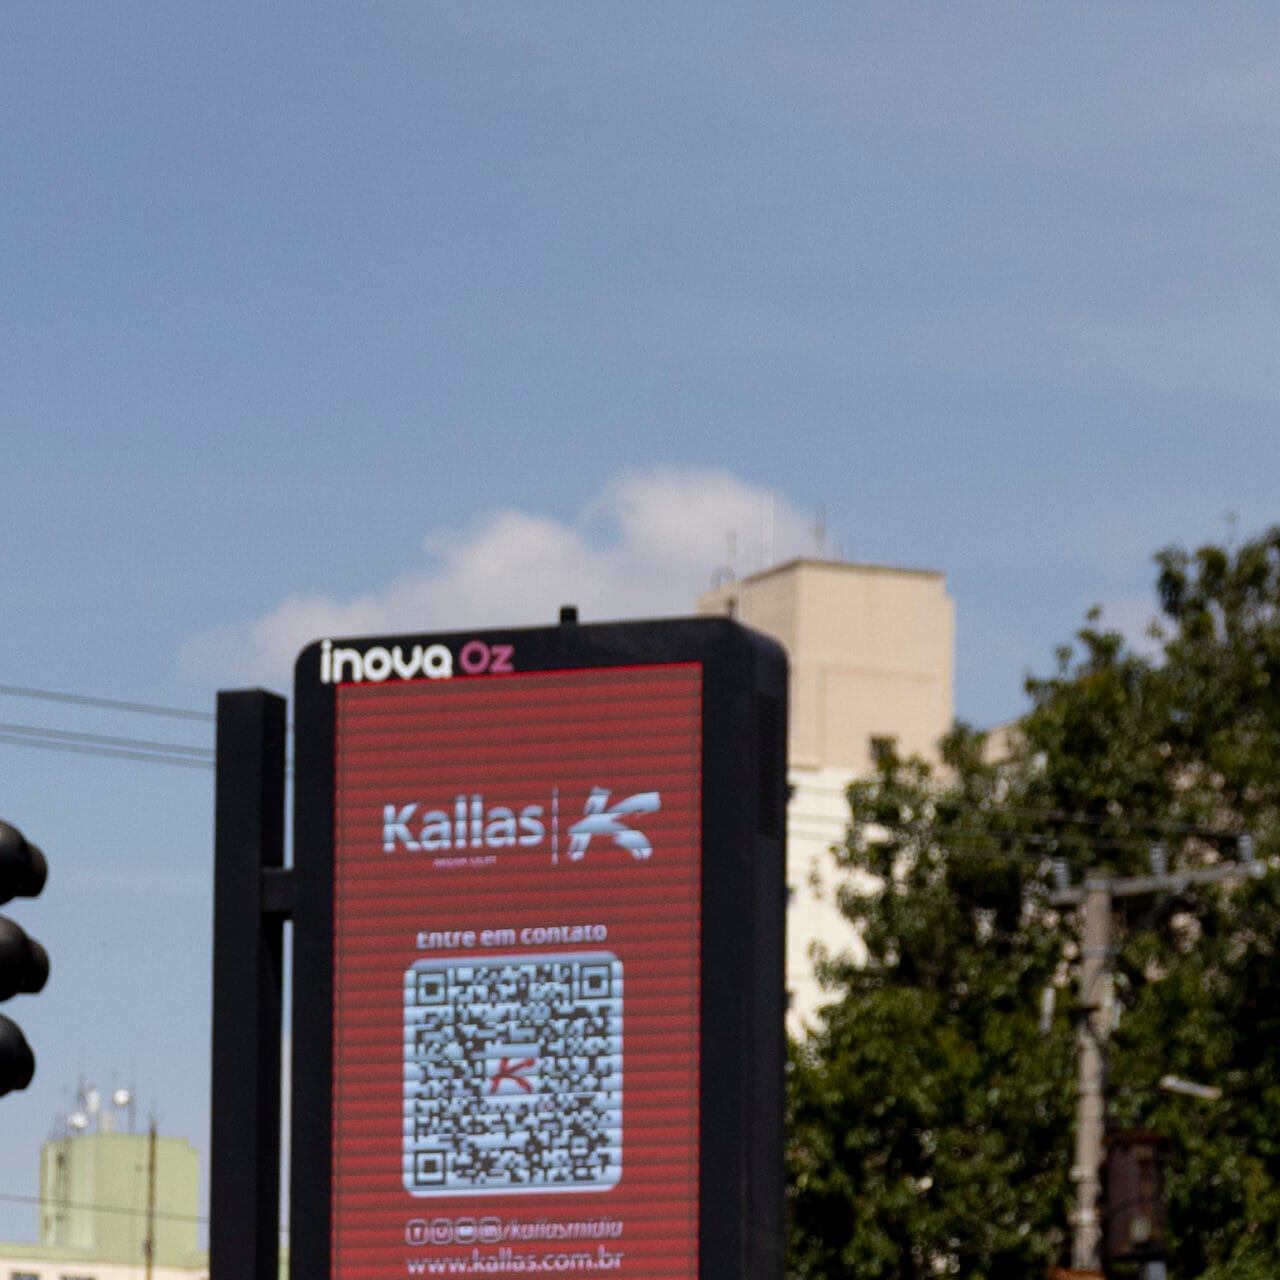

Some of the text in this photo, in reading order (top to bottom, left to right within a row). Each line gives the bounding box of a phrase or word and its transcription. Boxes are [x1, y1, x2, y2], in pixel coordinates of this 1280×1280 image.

[320, 638, 453, 685] inova
[382, 793, 546, 853] Kallas
[417, 923, 608, 949] Entre em contato
[406, 1245, 625, 1275] www.kallas.com.br
